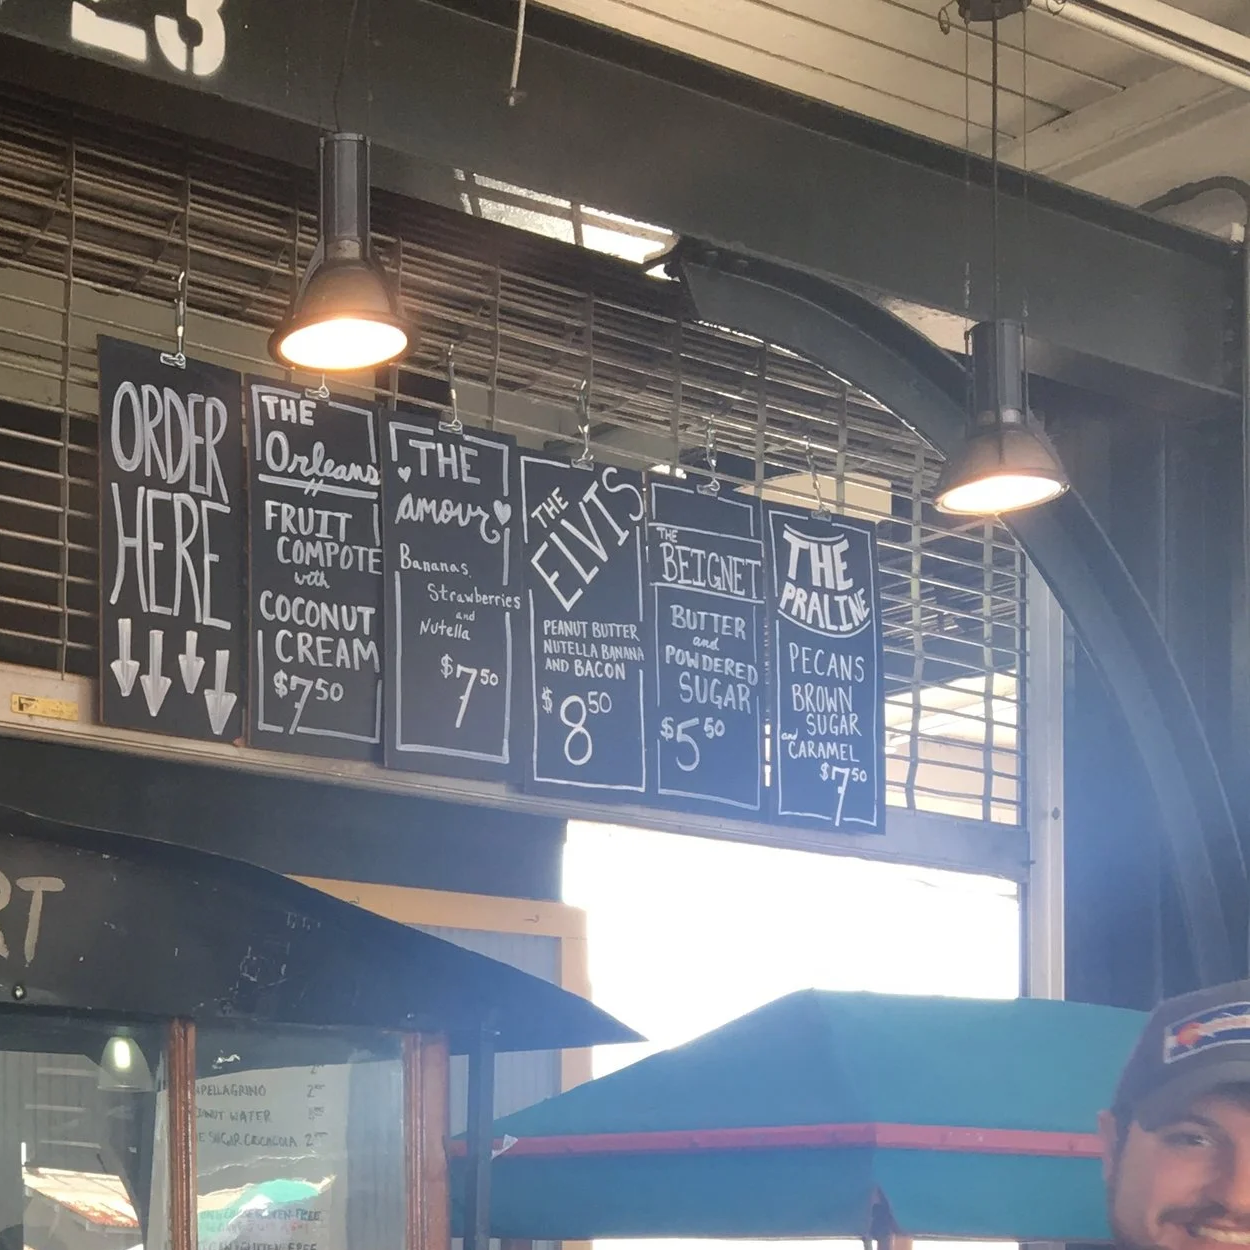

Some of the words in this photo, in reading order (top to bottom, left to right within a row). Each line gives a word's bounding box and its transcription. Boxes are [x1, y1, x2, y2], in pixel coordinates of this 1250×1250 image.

[261, 395, 317, 427] THE
[111, 381, 229, 503] ORDER
[265, 430, 381, 486] Orleans
[408, 439, 482, 485] THE
[264, 500, 352, 543] FRUIT
[531, 487, 569, 528] THE
[531, 466, 644, 613] ELVIS
[656, 527, 678, 543] THE
[110, 483, 232, 631] HERE
[276, 536, 383, 575] COMPOTE
[659, 542, 761, 599] BEIGNET
[782, 529, 854, 591] THE
[294, 569, 330, 590] with
[427, 583, 521, 610] Strawberries
[259, 590, 376, 634] COCONUT
[455, 610, 476, 622] and
[670, 604, 746, 640] BUTTER
[778, 582, 871, 633] PRALINE
[419, 618, 471, 641] Nutella
[543, 620, 590, 639] PEANUT
[591, 621, 640, 642] BUTTER
[692, 634, 720, 651] and
[275, 629, 381, 674] CREAM
[543, 639, 599, 659] NUTELLA
[601, 643, 645, 662] BANANA
[545, 656, 570, 673] AND
[574, 658, 626, 681] BACON
[665, 645, 759, 686] POWDERED
[789, 642, 865, 683] PECANS
[679, 672, 752, 714] SUGAR
[792, 683, 853, 714] BROWN
[781, 730, 799, 742] and
[806, 713, 862, 737] SUGAR
[787, 741, 860, 763] CARAMEL
